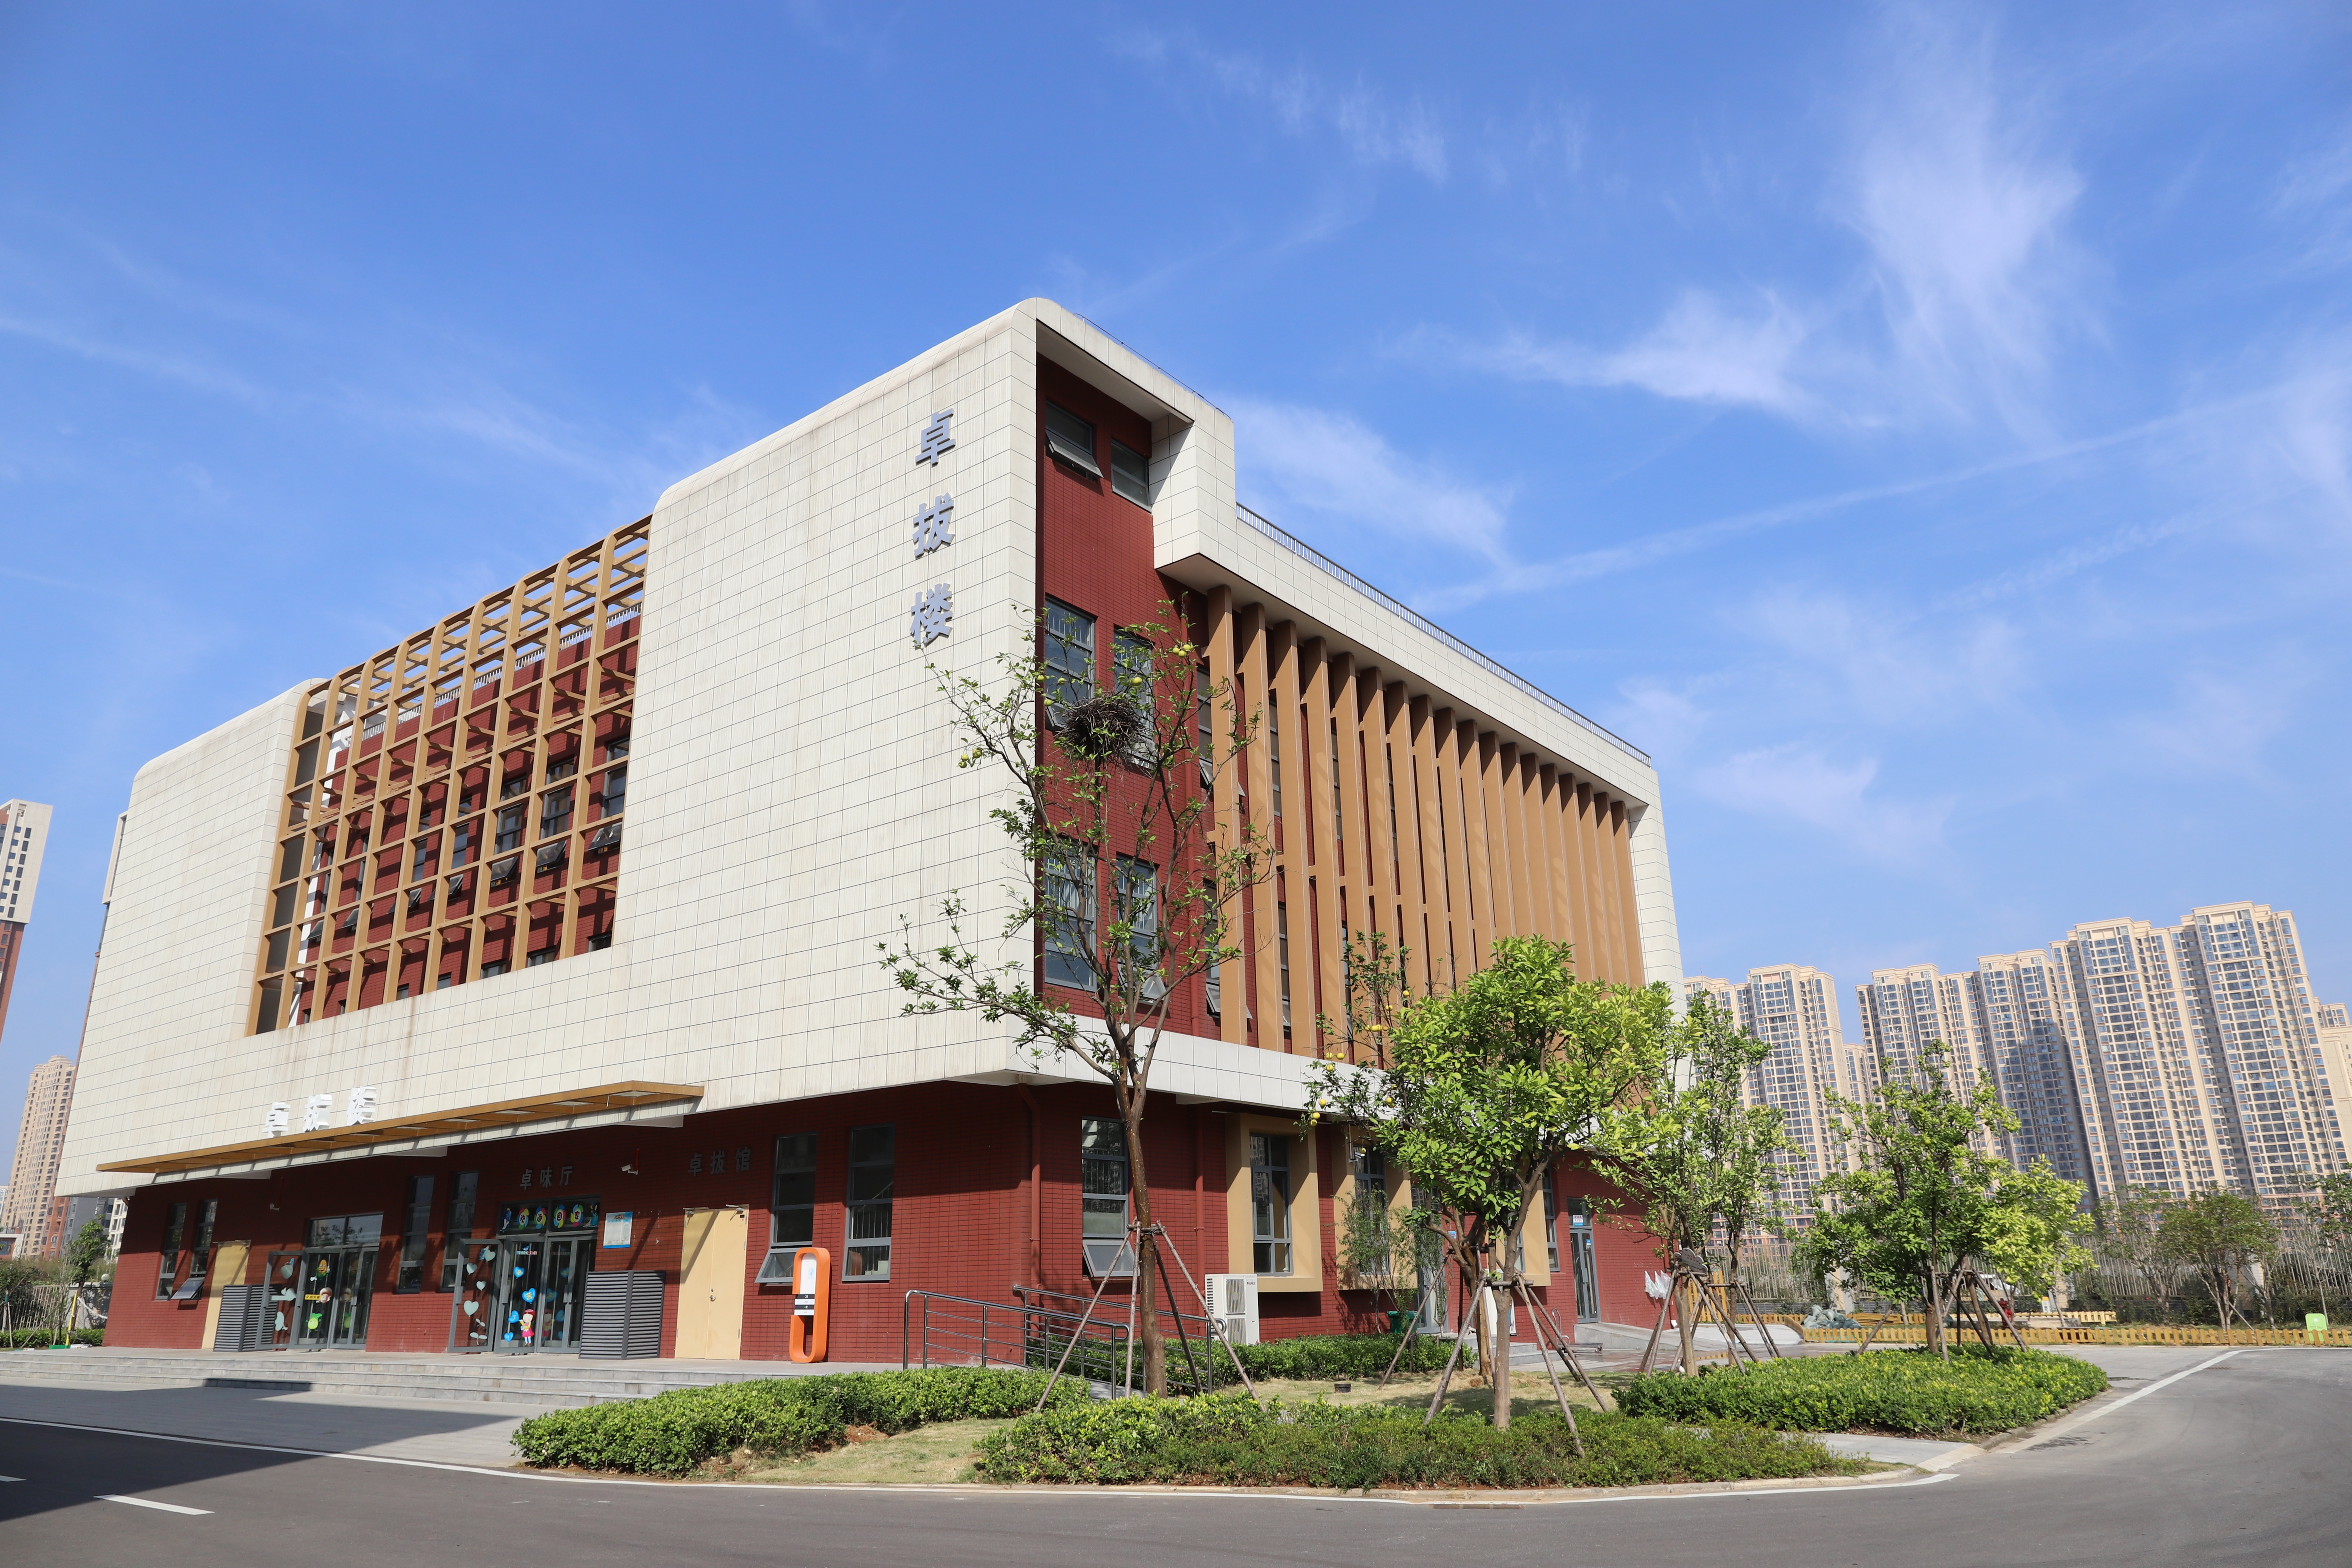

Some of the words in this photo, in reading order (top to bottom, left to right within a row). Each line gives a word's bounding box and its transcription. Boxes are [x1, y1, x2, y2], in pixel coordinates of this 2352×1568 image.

[910, 408, 956, 650] 卓拔楼
[262, 1086, 377, 1138] 卓拔楼
[520, 1166, 572, 1190] 卓味厅
[688, 1147, 751, 1177] 卓拔馆
